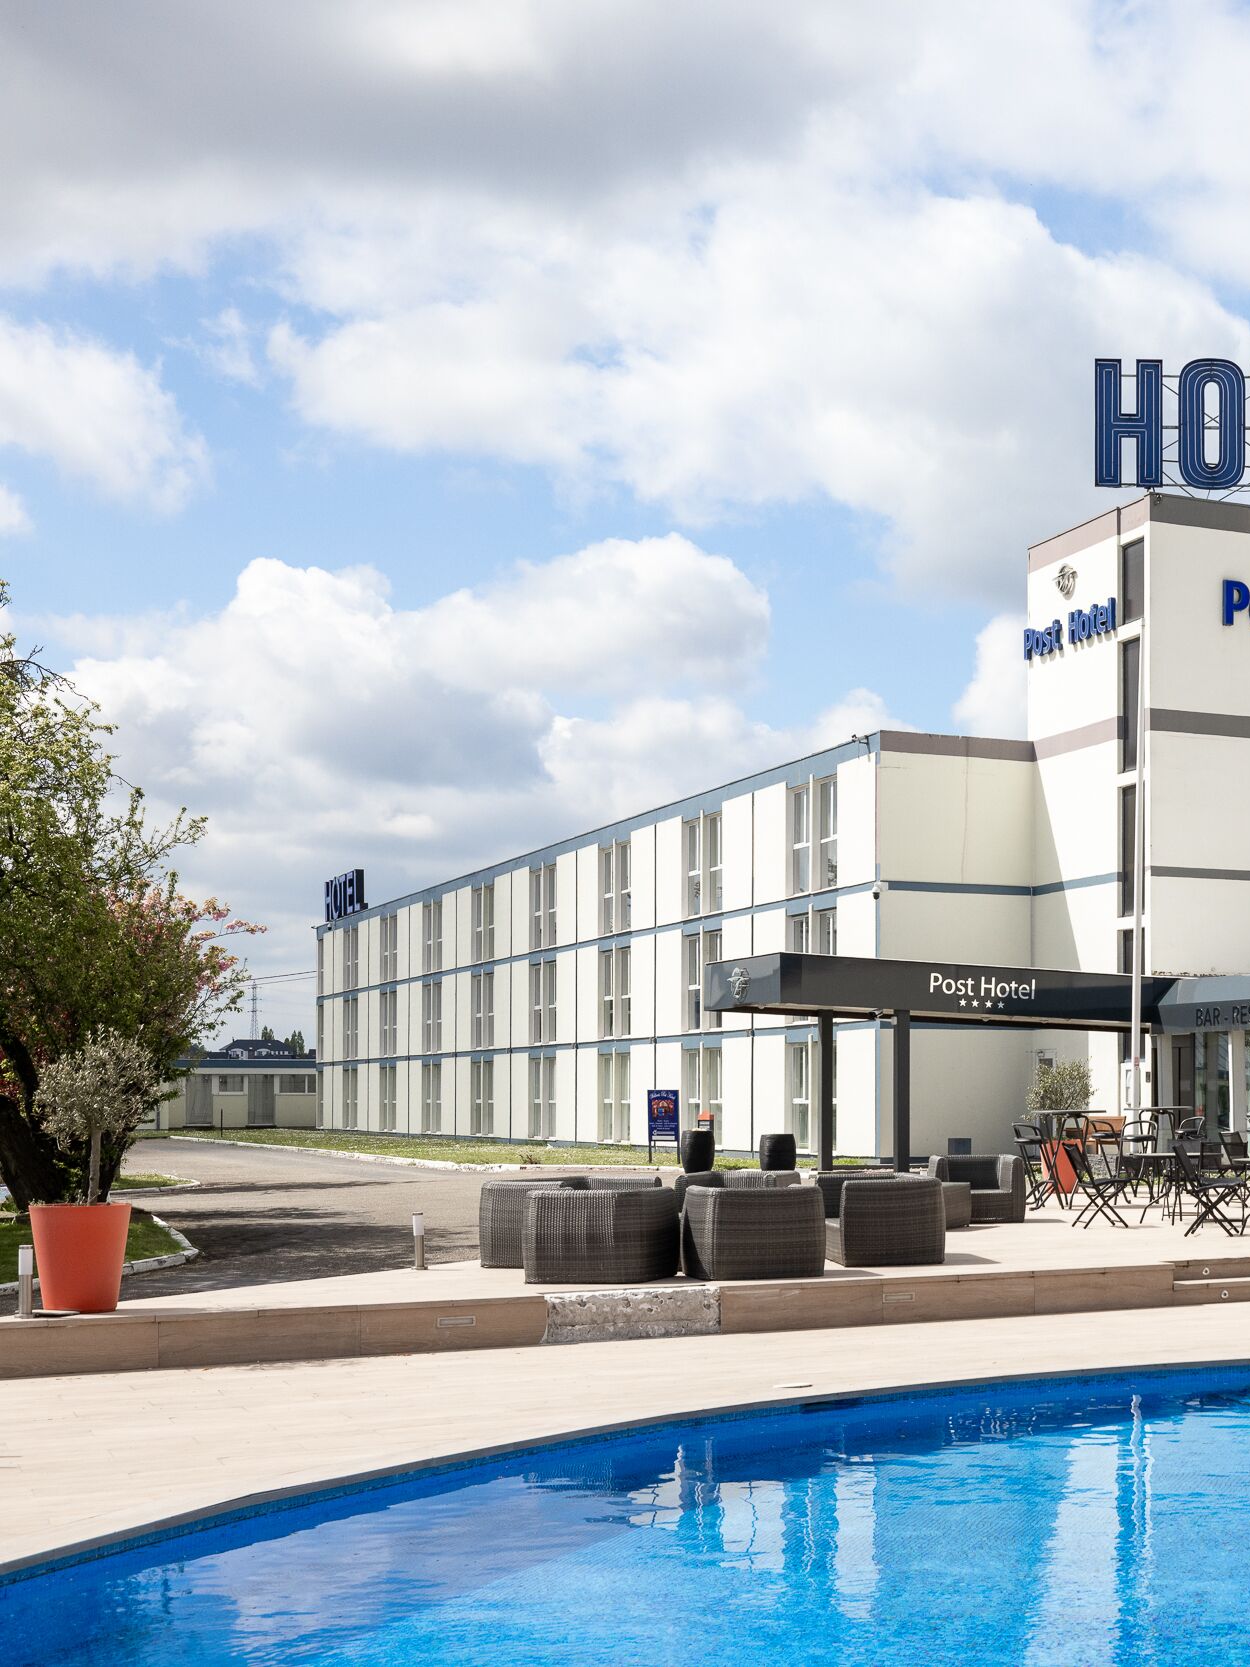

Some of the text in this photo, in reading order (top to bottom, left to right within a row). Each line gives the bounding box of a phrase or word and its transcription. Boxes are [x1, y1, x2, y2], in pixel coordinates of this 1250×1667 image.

[1024, 597, 1116, 661] Post Hotel
[324, 869, 368, 922] HOTEL
[929, 973, 1036, 1000] Post Hotel
[1195, 1007, 1220, 1027] BAR
